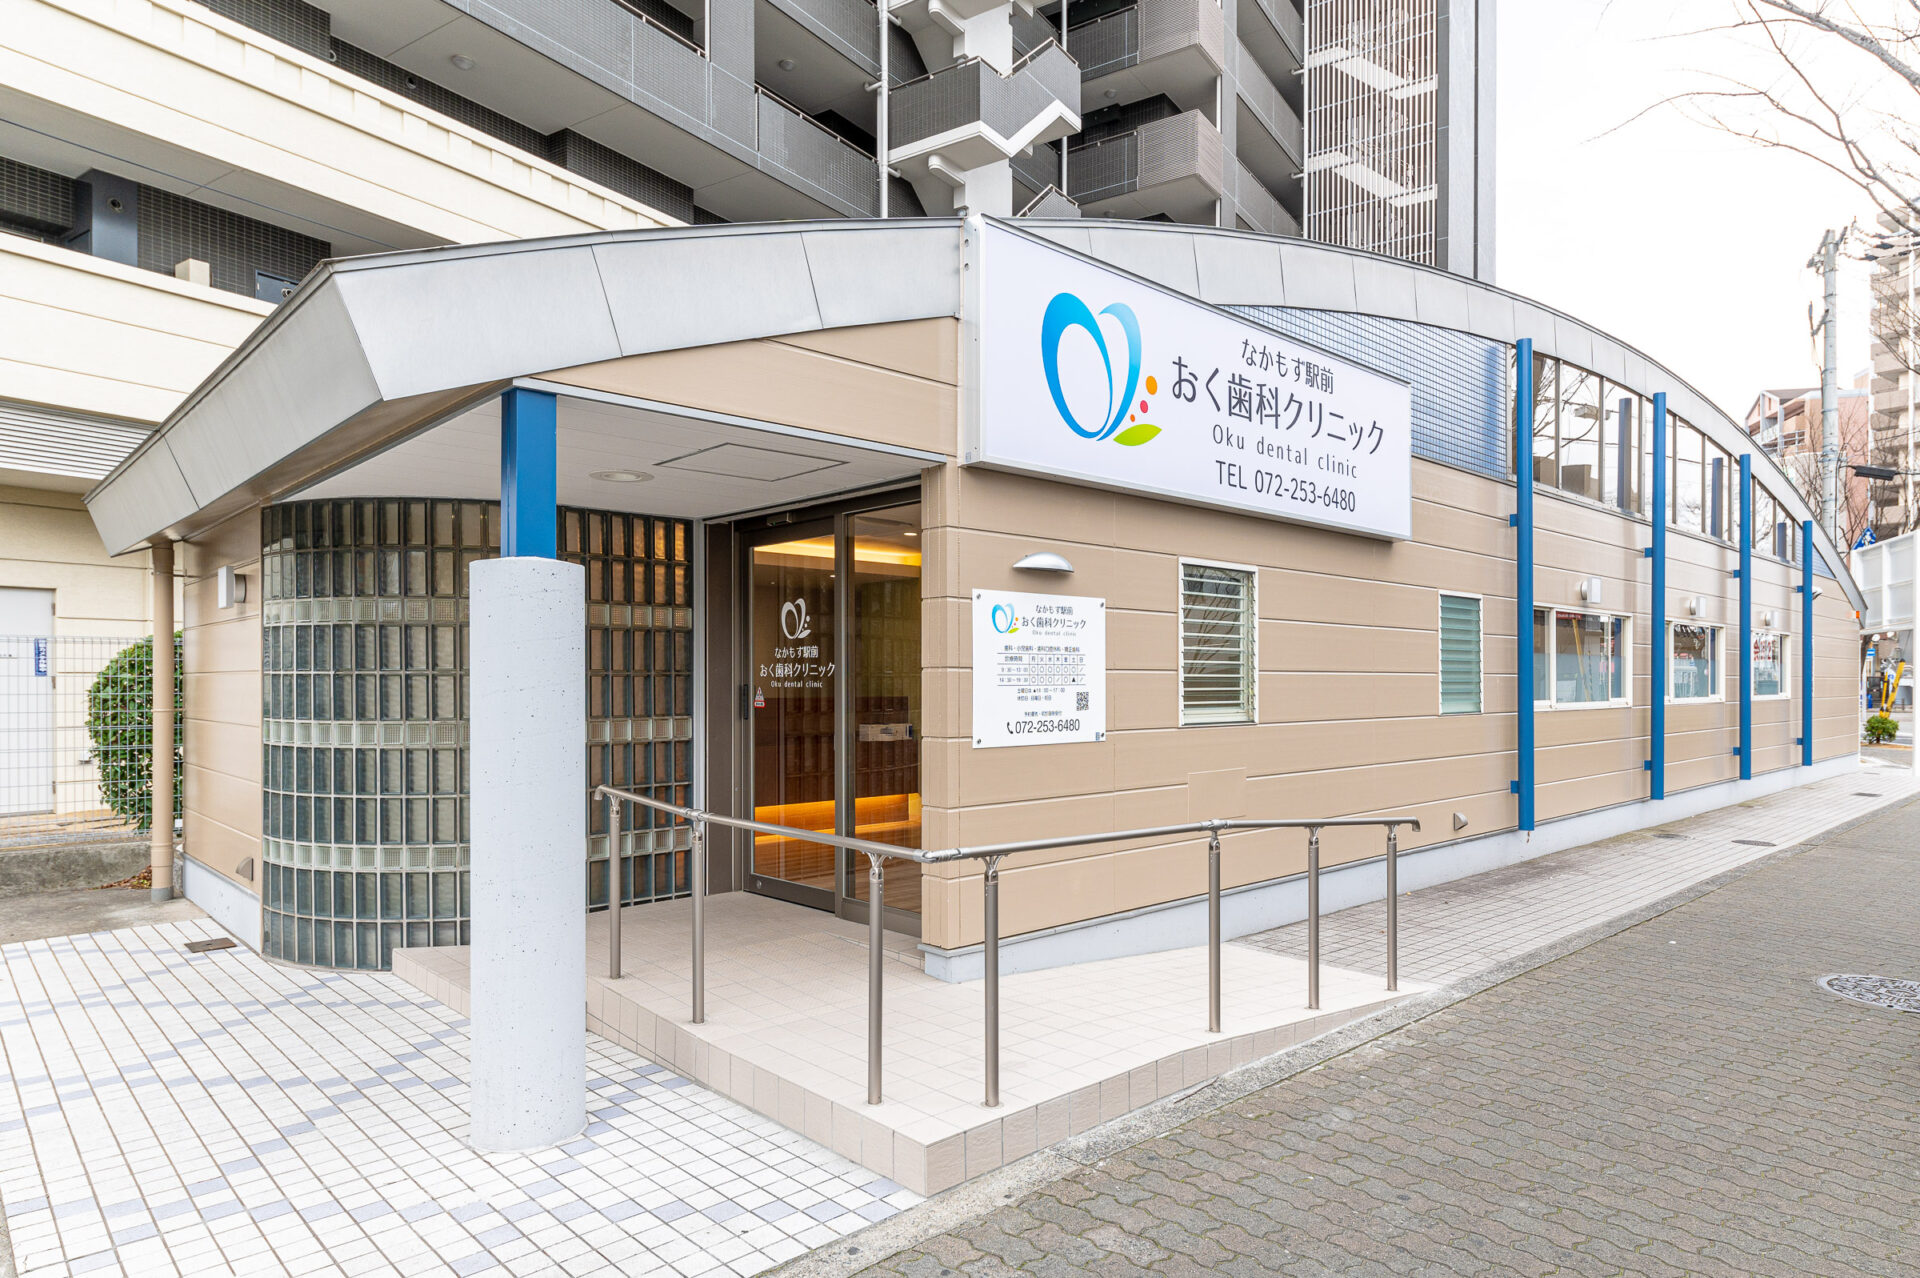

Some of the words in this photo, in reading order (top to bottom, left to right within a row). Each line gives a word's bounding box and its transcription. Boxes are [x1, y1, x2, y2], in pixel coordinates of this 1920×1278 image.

[1242, 338, 1334, 395] なかもず駅前
[1172, 356, 1384, 455] おく歯科クリニック
[1212, 424, 1245, 450] Oku
[1256, 436, 1308, 466] dental
[1318, 454, 1358, 479] clinic
[1215, 460, 1248, 490] TEL
[1255, 469, 1356, 513] 072-253-6480
[1021, 616, 1087, 630] おく歯科クリニック
[774, 645, 819, 659] なかもず駅前
[759, 662, 836, 678] おく歯科クリニック
[770, 680, 782, 688] Oku
[784, 680, 803, 688] dental
[805, 680, 823, 688] clinic
[1015, 718, 1080, 735] 072-253-6480
